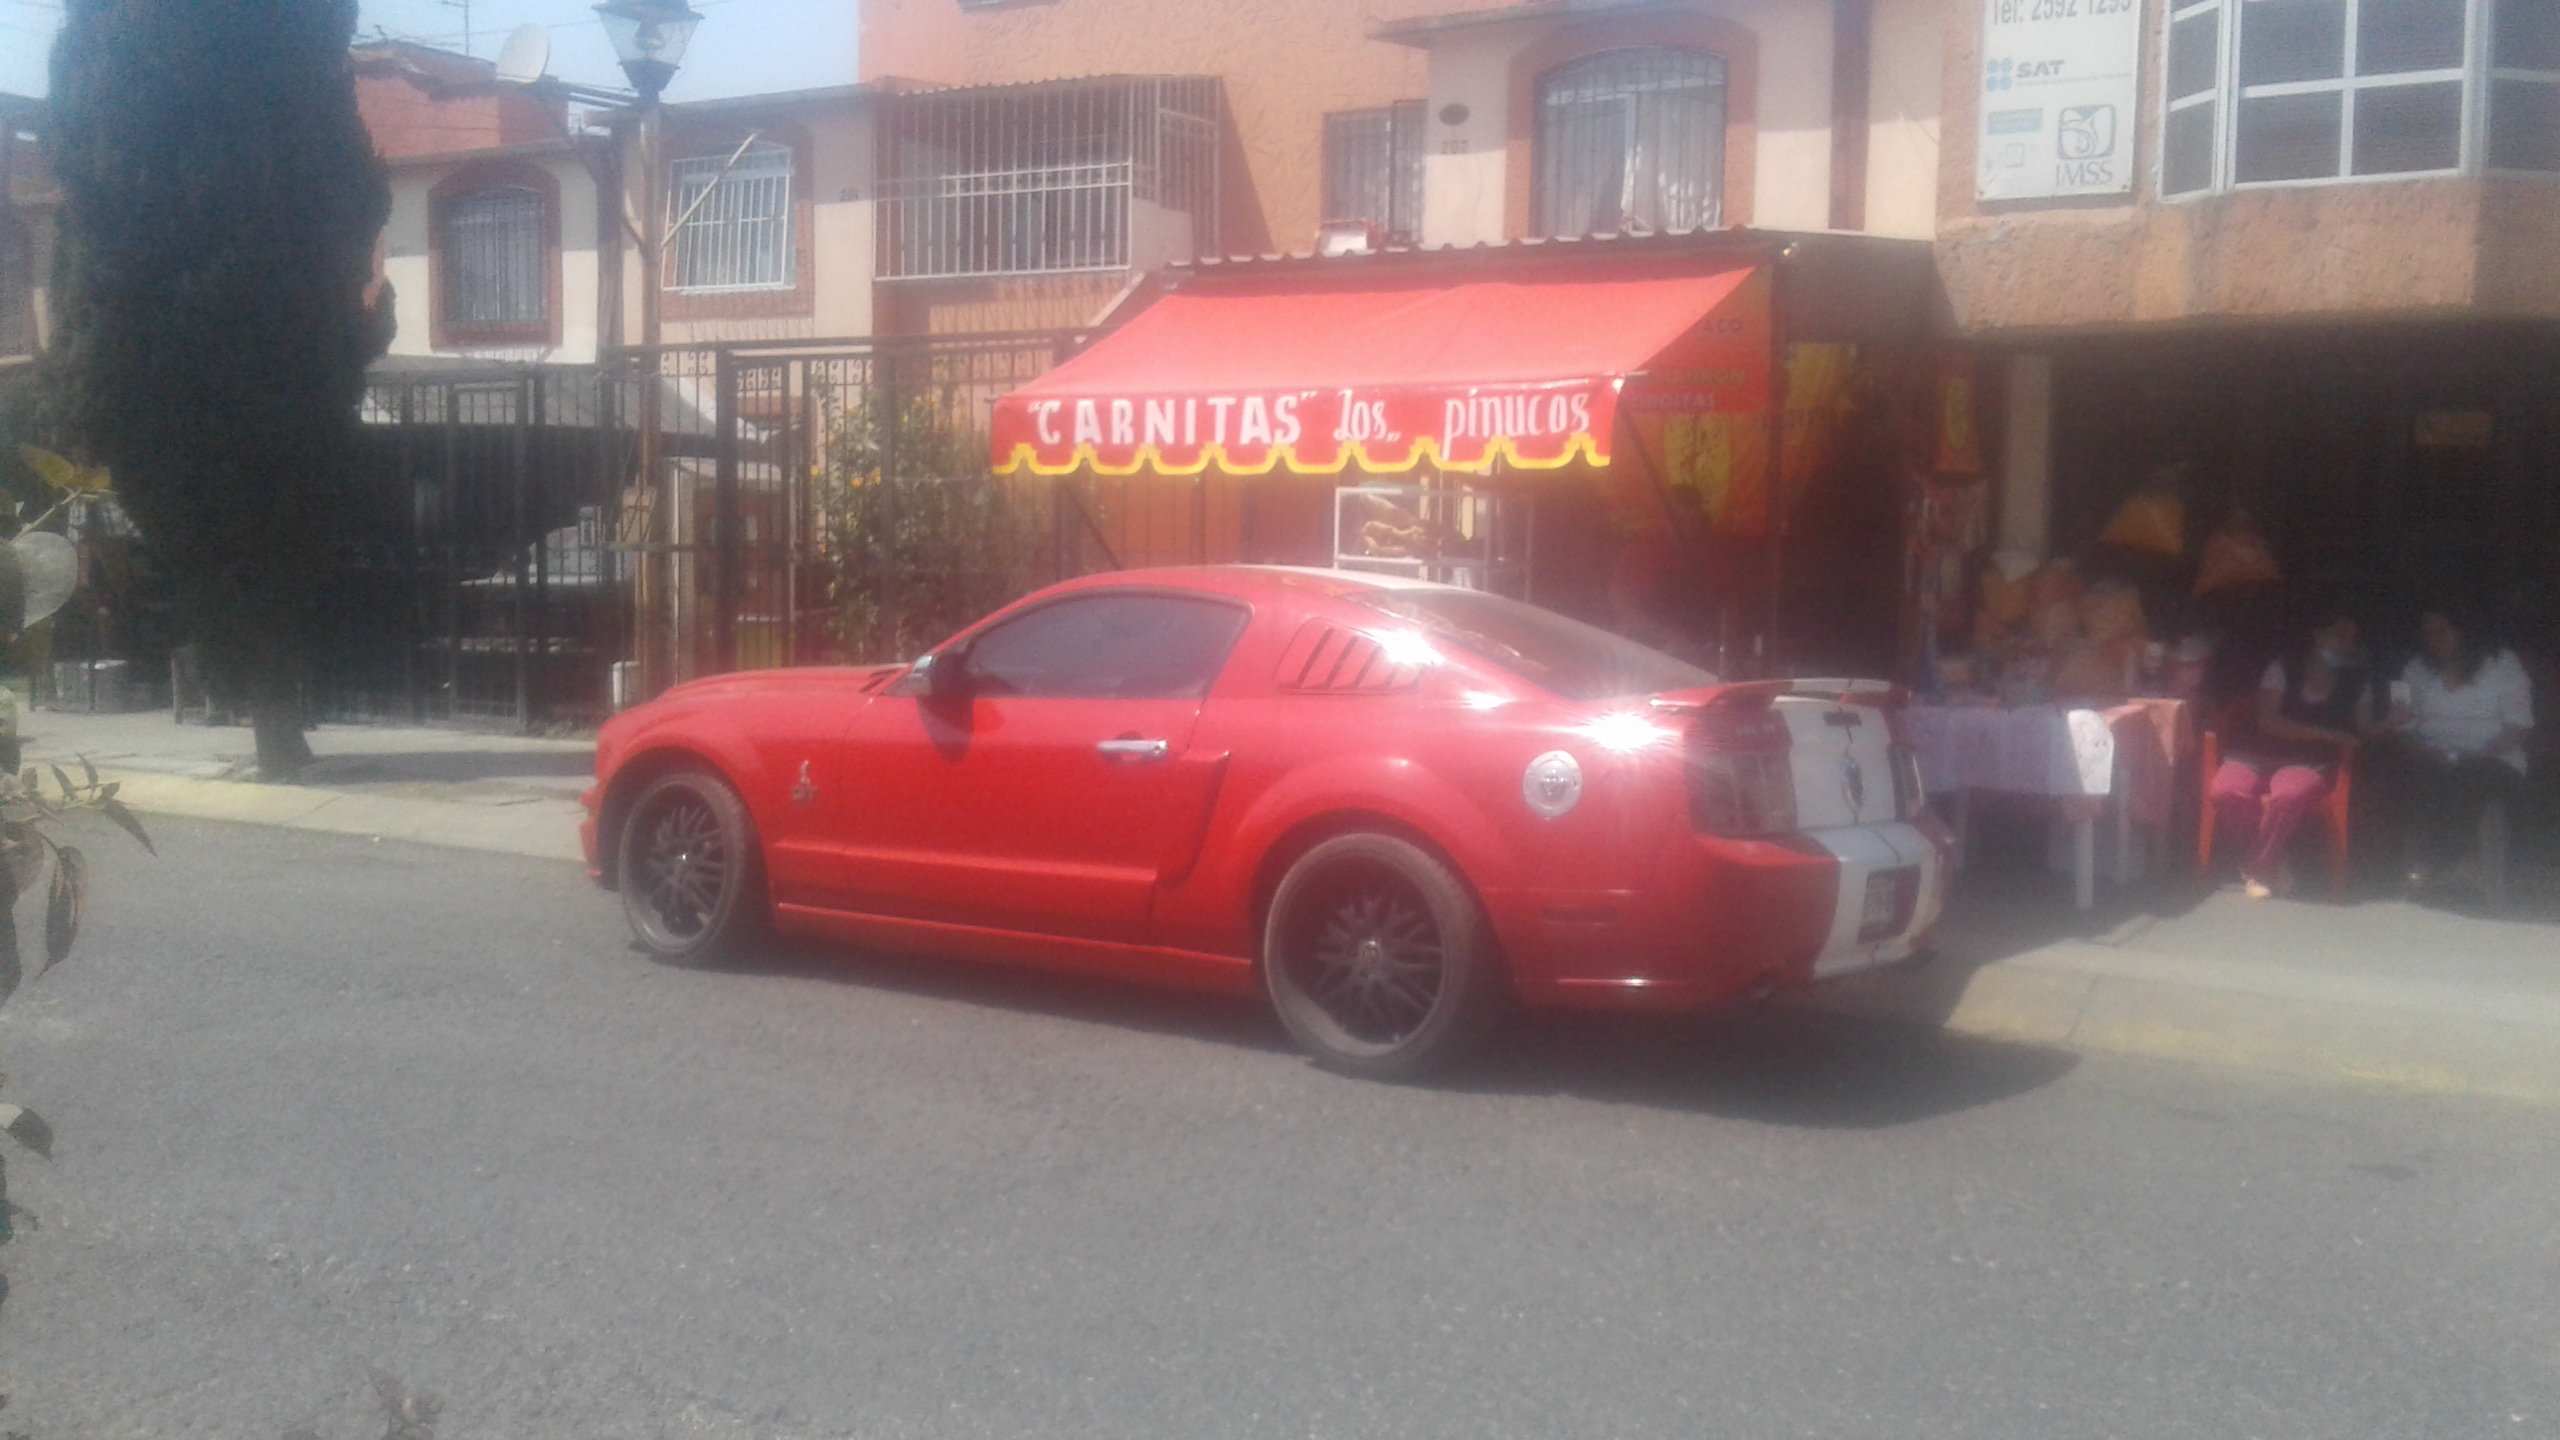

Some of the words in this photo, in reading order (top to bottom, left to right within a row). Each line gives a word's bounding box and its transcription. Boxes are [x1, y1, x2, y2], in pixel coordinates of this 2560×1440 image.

[2016, 59, 2065, 78] SAT
[2056, 161, 2113, 187] IMSS
[1442, 388, 1590, 462] pinucos
